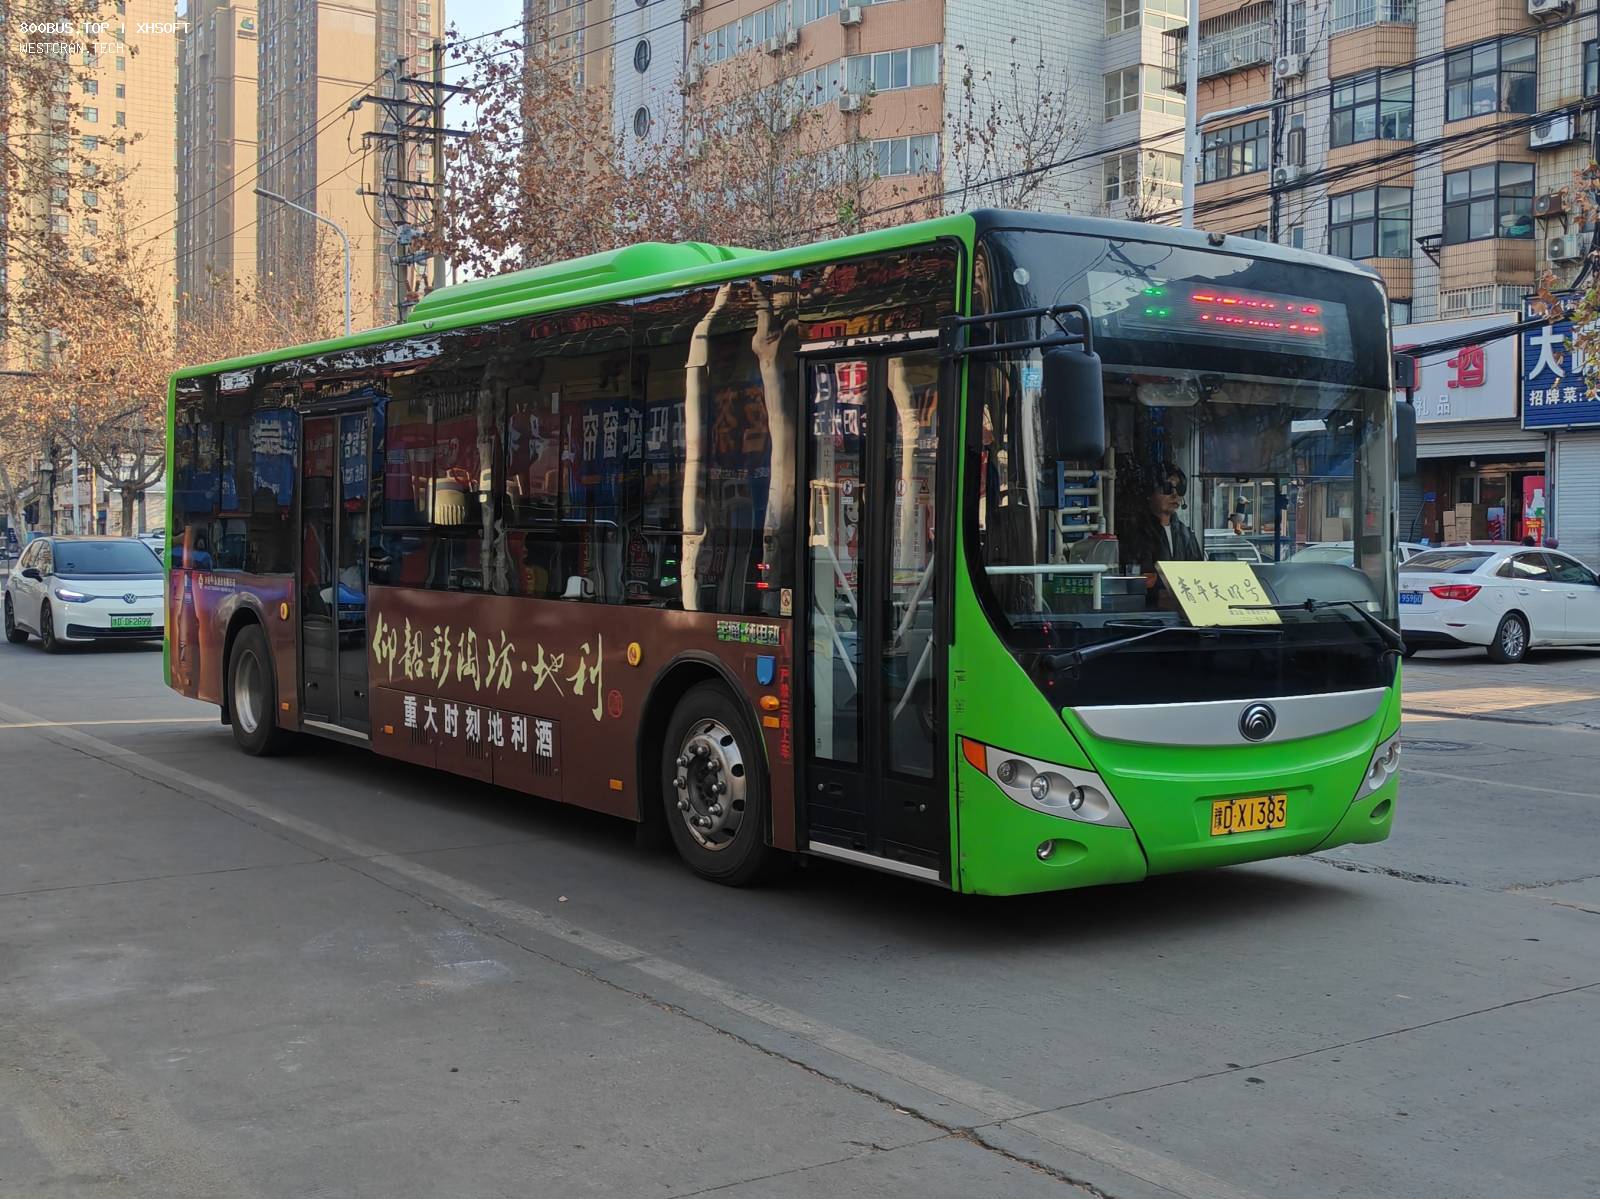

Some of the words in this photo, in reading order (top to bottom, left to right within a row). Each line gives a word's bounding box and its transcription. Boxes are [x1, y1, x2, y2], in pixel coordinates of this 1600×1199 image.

[403, 695, 553, 758] 重大时刻地利酒
